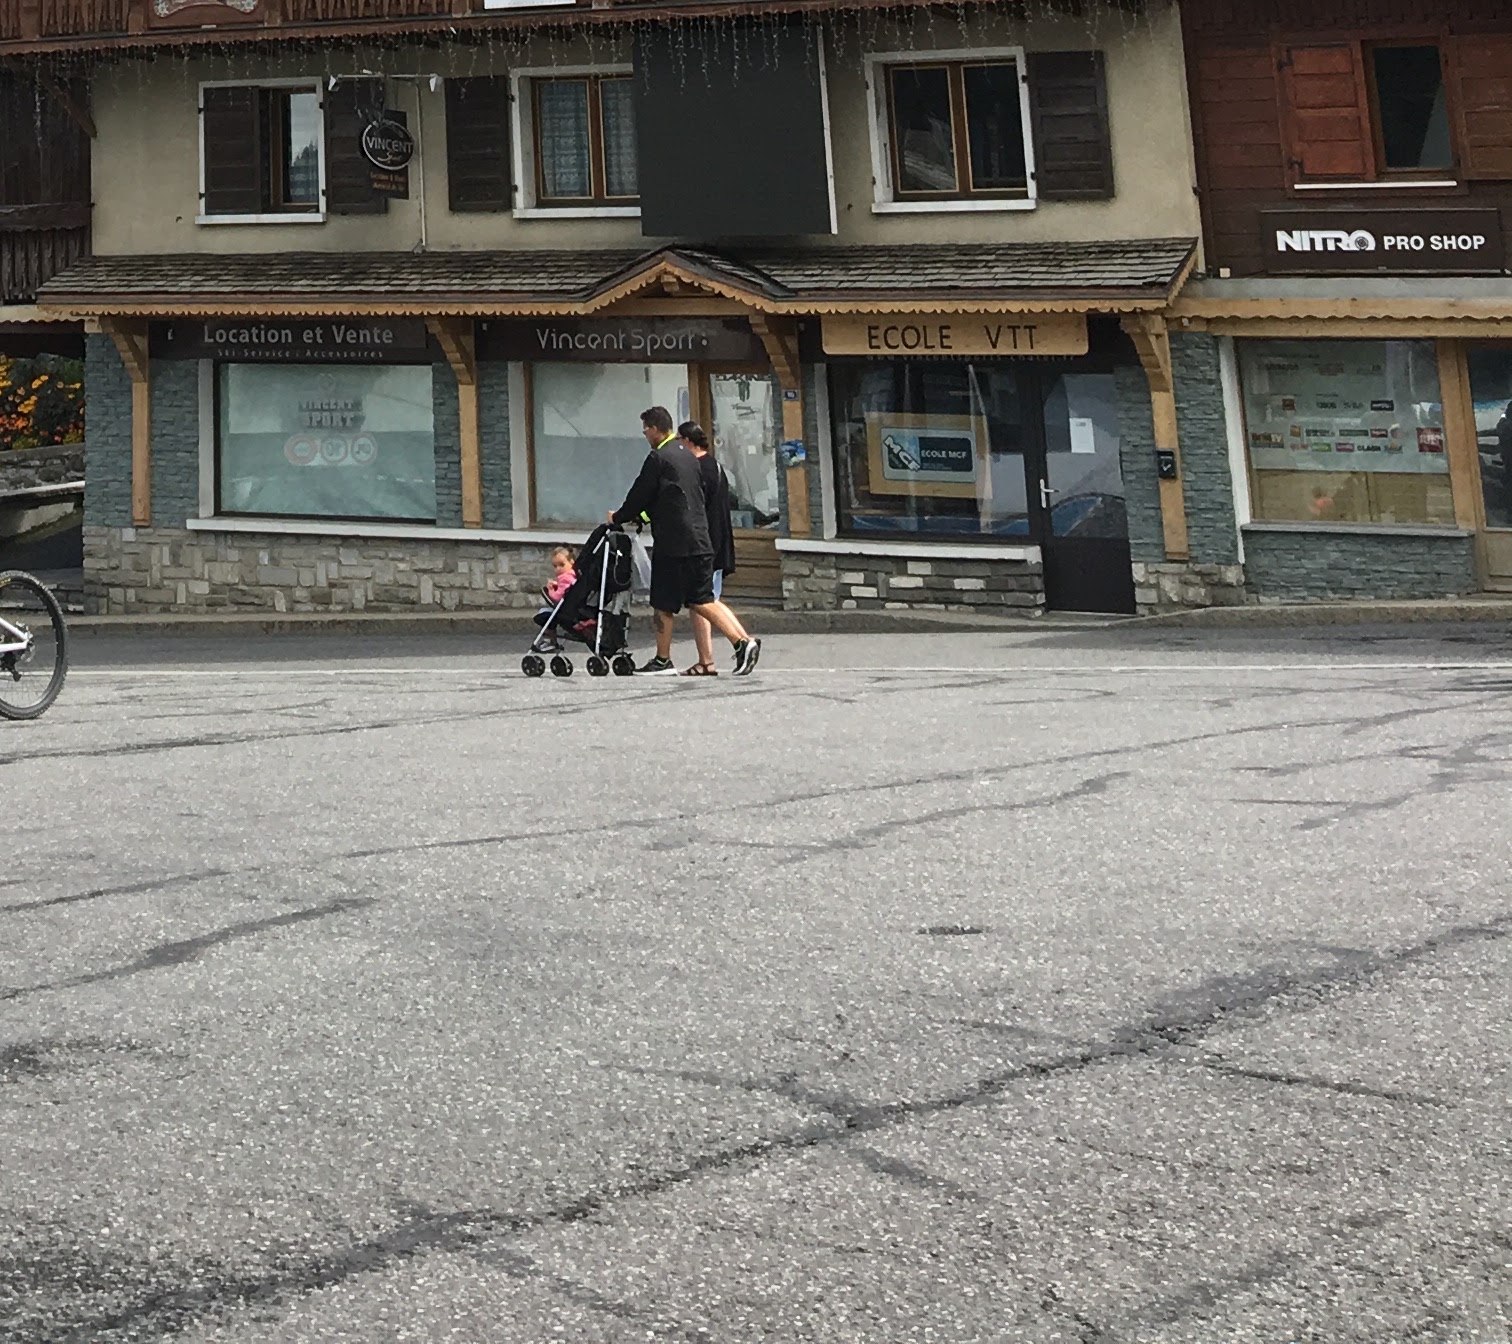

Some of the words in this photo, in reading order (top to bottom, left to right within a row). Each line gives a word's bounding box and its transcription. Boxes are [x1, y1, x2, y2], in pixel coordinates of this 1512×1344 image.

[367, 136, 413, 153] VINCENT
[1276, 230, 1376, 252] NITRO
[1383, 235, 1425, 250] PRO
[1430, 235, 1486, 250] SHOP
[204, 325, 292, 343] Location
[303, 327, 323, 343] et
[332, 325, 394, 343] Vente
[868, 325, 953, 349] ECOLE
[984, 325, 1037, 349] VTT
[243, 348, 290, 357] Service
[921, 450, 946, 458] ECOLE
[949, 450, 967, 459] MCF
